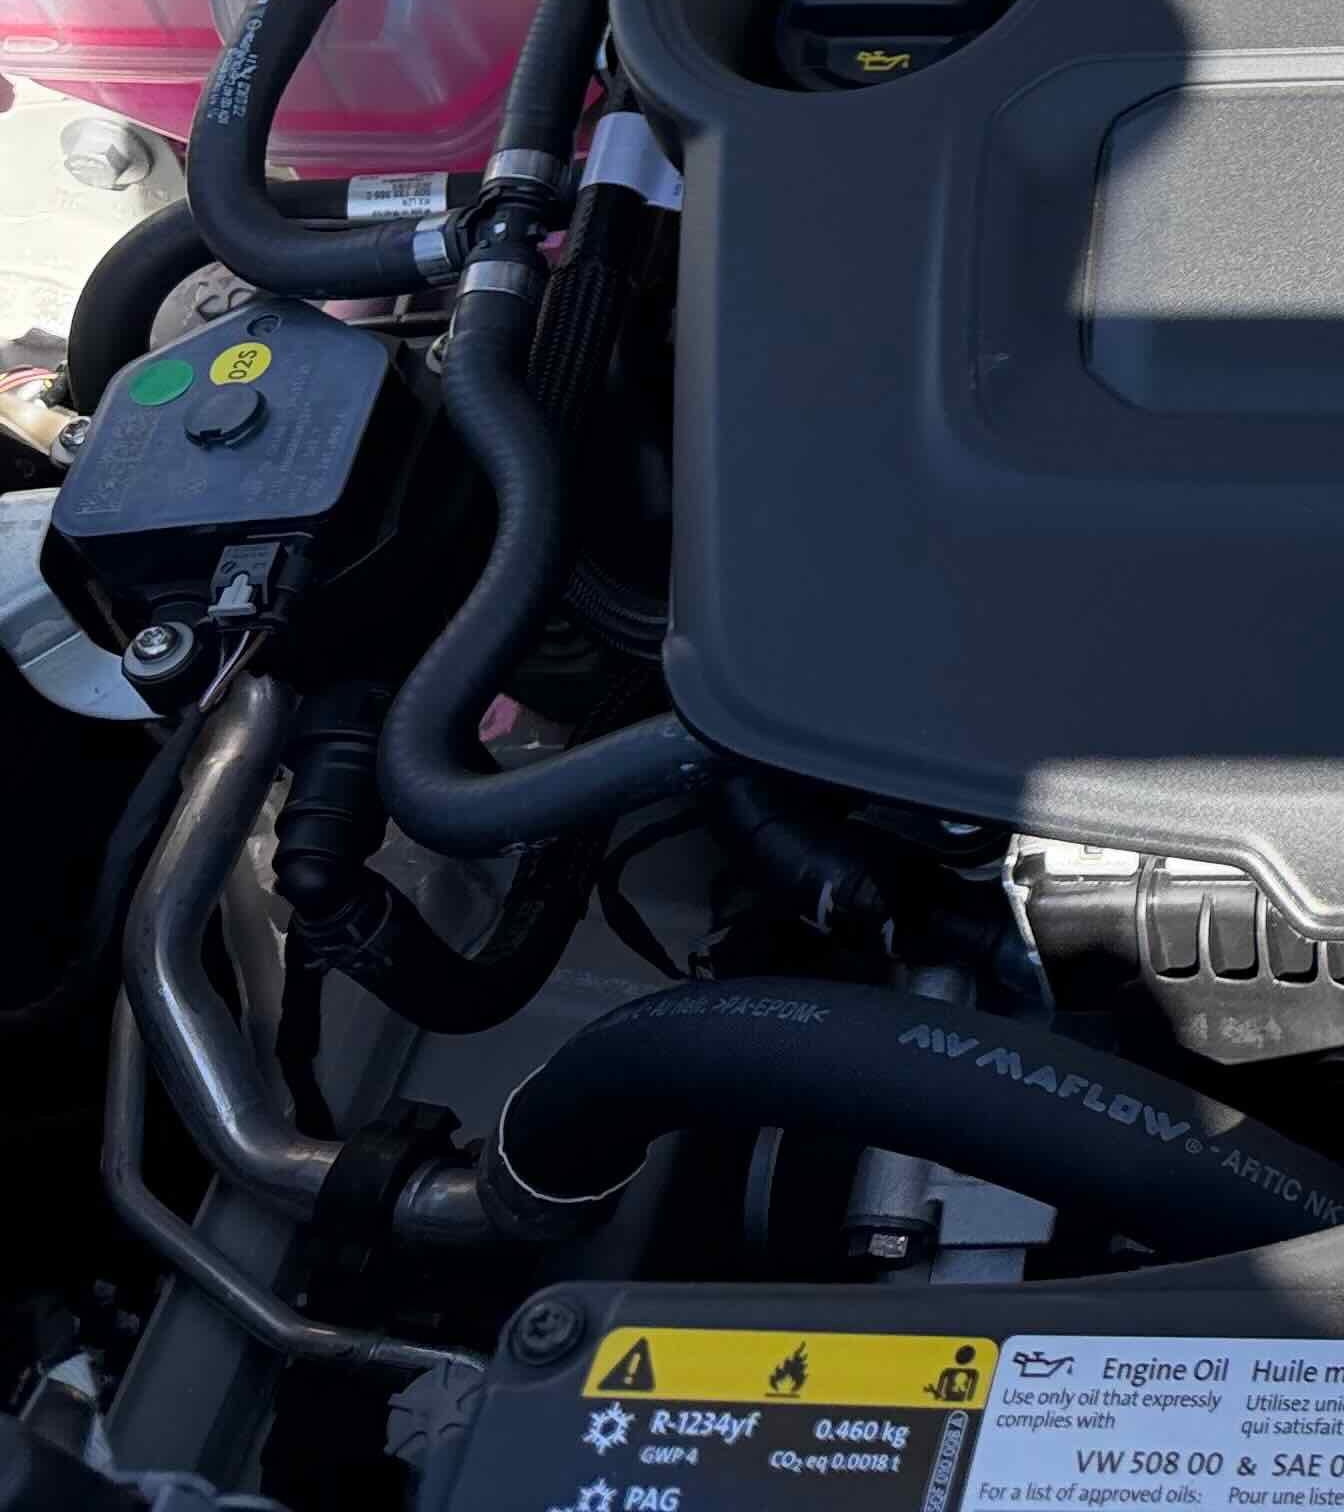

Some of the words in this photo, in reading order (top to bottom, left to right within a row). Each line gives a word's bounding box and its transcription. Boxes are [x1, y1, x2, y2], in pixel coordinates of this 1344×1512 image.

[1103, 1357, 1186, 1387] Engine
[1194, 1358, 1229, 1382] Oil
[1252, 1360, 1317, 1383] Huile
[1002, 1388, 1034, 1406] Use
[1038, 1388, 1074, 1409] only
[1078, 1389, 1100, 1407] oil
[1103, 1390, 1138, 1407] that
[1142, 1392, 1223, 1412] expressly
[1247, 1394, 1310, 1412] Utilisez
[651, 1409, 761, 1444] R-1234yf
[996, 1412, 1073, 1431] complies
[1077, 1413, 1116, 1429] with
[1241, 1419, 1270, 1437] qui
[1273, 1418, 1344, 1435] satisfait
[815, 1419, 878, 1441] 0.460
[882, 1422, 910, 1449] kg
[639, 1445, 683, 1464] GWP
[686, 1446, 699, 1464] 4
[806, 1457, 828, 1473] eq
[831, 1453, 888, 1472] 0.0018
[891, 1455, 901, 1472] t
[1077, 1449, 1125, 1473] VW
[1130, 1451, 1180, 1474] 508
[1187, 1452, 1224, 1475] 00
[1237, 1456, 1257, 1476] &
[1273, 1455, 1324, 1478] SAE
[624, 1486, 681, 1512] PAG
[979, 1483, 1008, 1501] For
[1010, 1488, 1021, 1502] a
[1026, 1484, 1052, 1502] list
[1055, 1484, 1078, 1502] of
[1079, 1486, 1162, 1506] approved
[1166, 1485, 1202, 1504] oils:
[1229, 1488, 1270, 1506] Pour
[1272, 1492, 1304, 1506] une
[1309, 1489, 1344, 1507] liste
